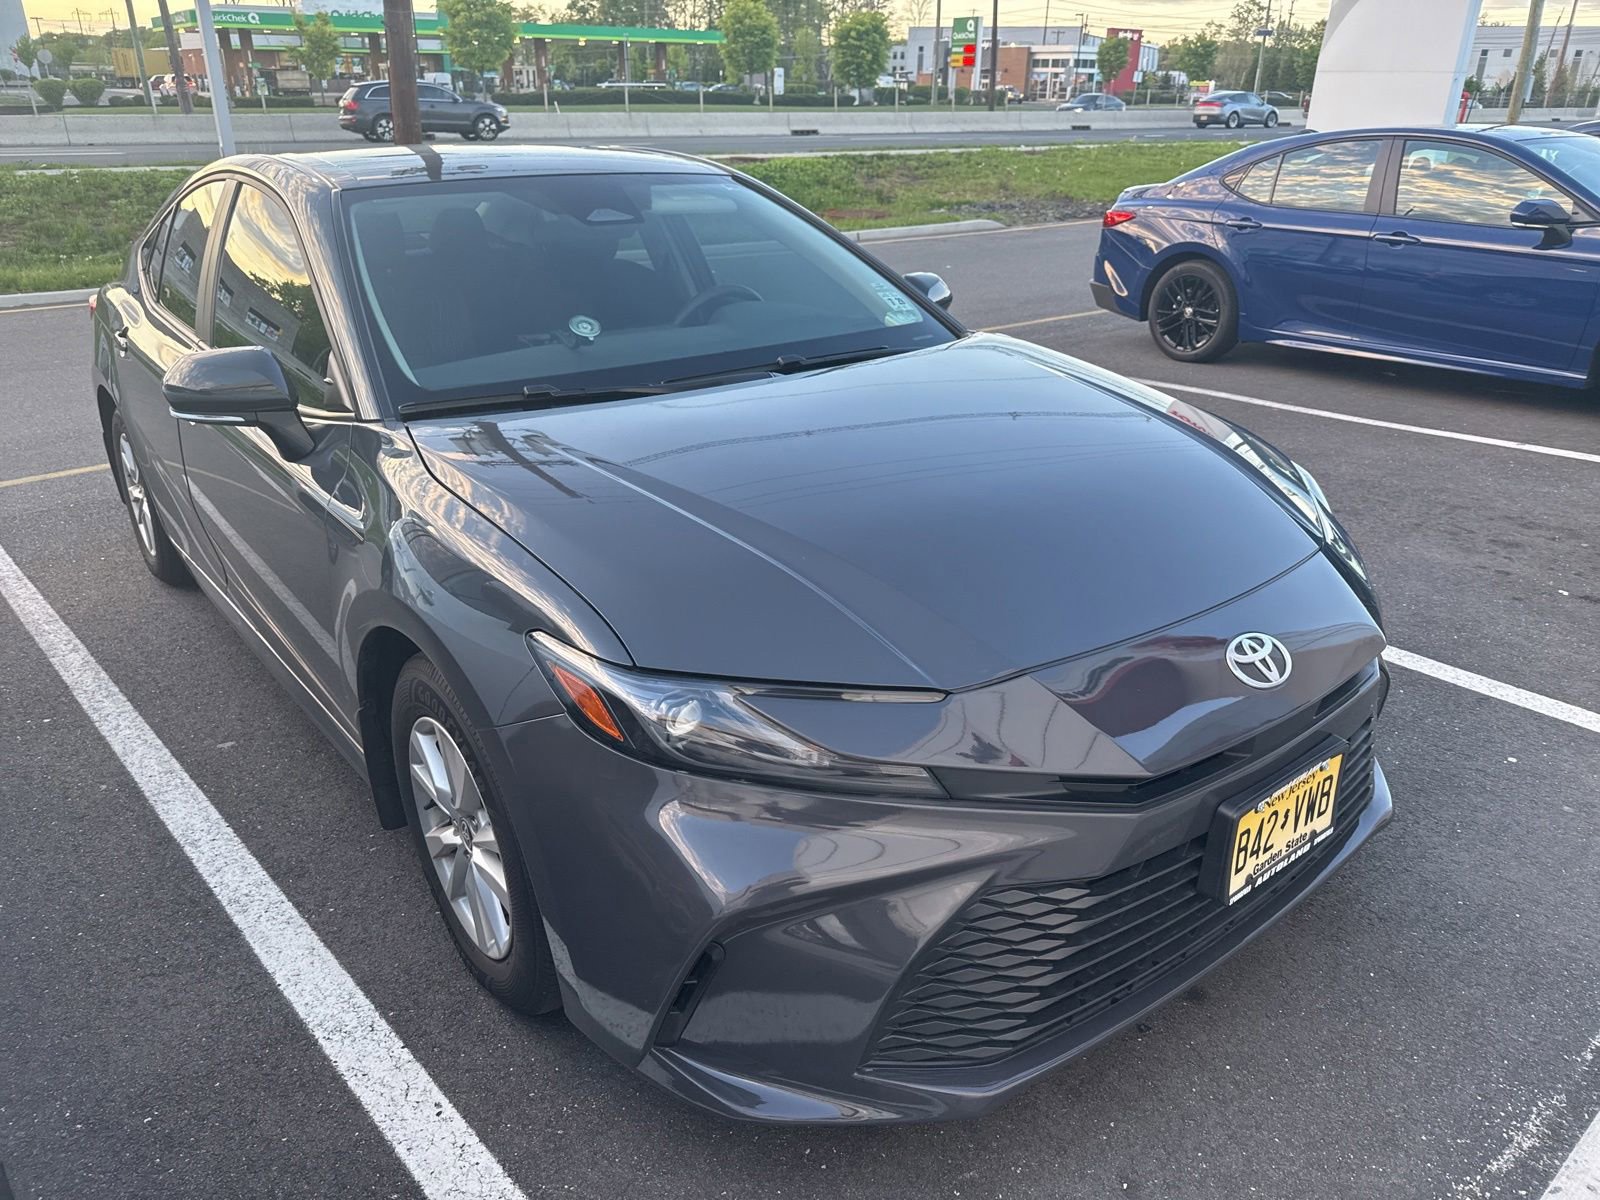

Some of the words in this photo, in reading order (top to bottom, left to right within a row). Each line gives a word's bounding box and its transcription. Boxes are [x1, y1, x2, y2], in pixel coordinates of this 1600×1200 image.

[212, 13, 247, 23] uickChek
[1285, 770, 1318, 800] Jersey
[1253, 849, 1283, 876] Garden
[1285, 832, 1308, 853] State
